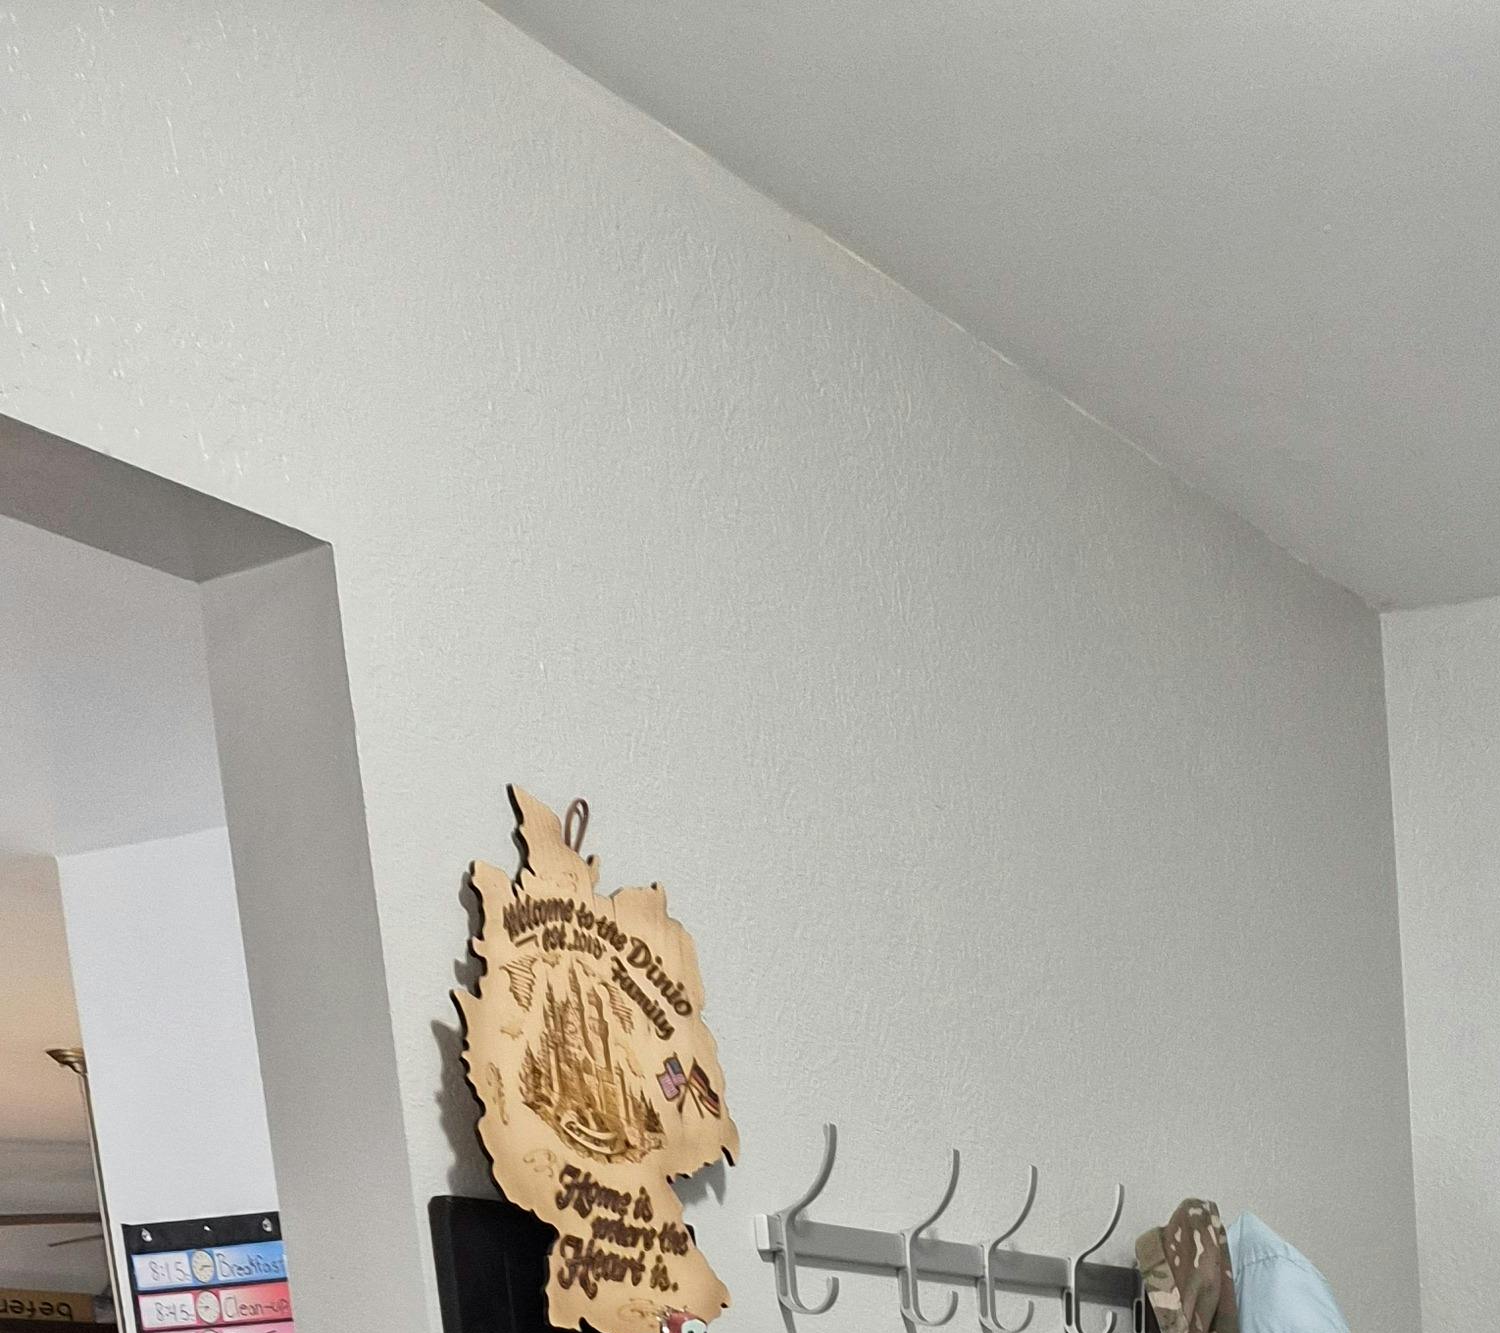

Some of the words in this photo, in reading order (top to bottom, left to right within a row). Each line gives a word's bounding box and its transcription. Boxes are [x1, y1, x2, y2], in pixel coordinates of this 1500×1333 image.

[576, 902, 594, 930] to
[596, 916, 627, 951] the
[627, 936, 692, 1016] Dinio
[611, 956, 675, 1041] Family
[555, 1164, 632, 1219] Home
[633, 1186, 653, 1222] is
[591, 1216, 656, 1251] where
[659, 1222, 688, 1256] the
[150, 1261, 186, 1283] 8:15
[558, 1235, 645, 1299] Heart
[651, 1255, 678, 1292] is.
[155, 1302, 190, 1323] 8:45
